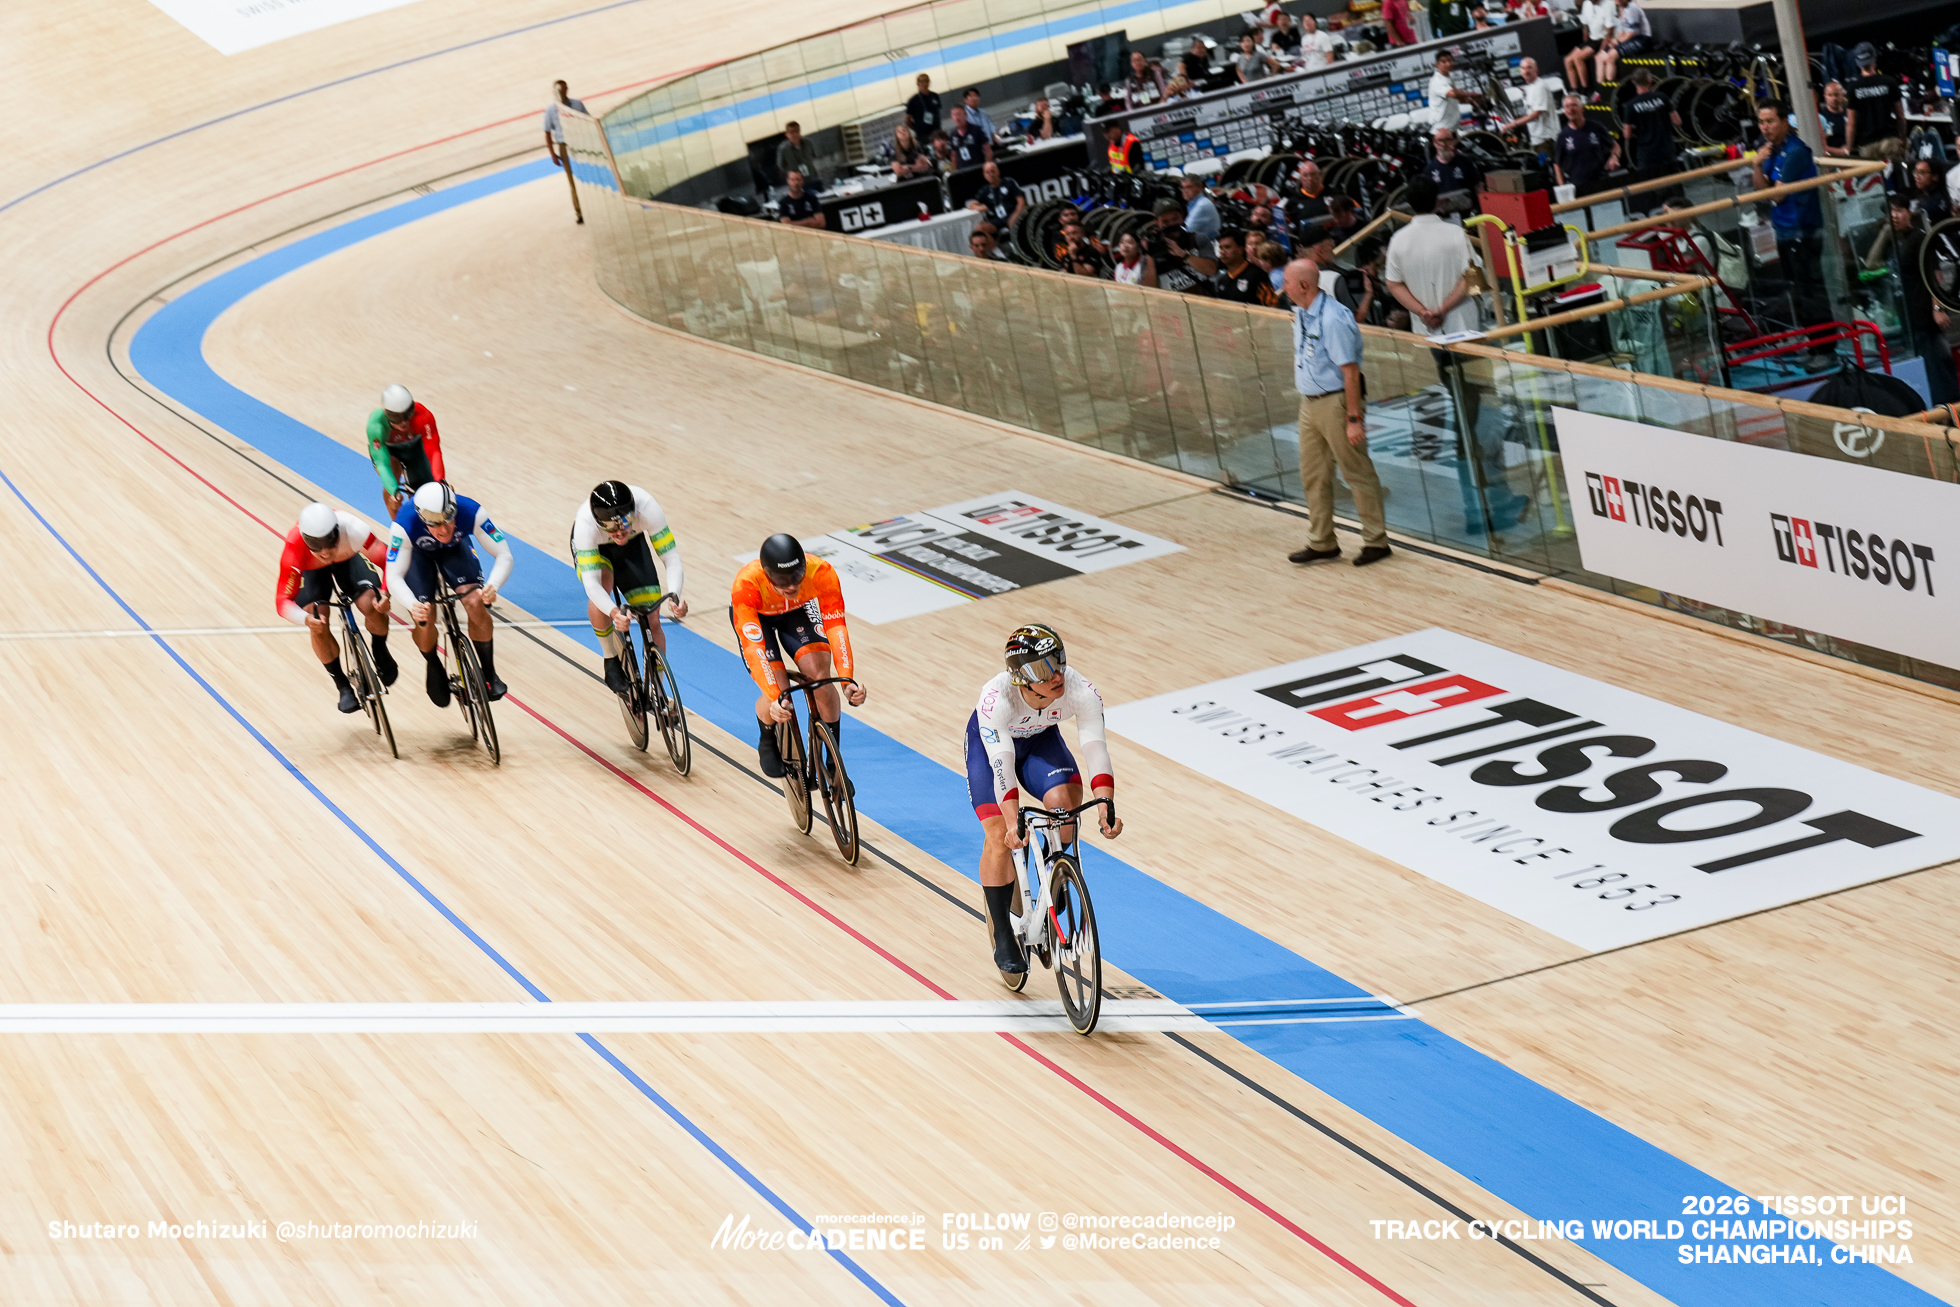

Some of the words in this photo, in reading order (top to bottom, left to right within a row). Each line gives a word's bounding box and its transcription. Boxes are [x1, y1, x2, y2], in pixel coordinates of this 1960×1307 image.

[996, 512, 1147, 559] TISSOT
[1622, 478, 1725, 548] TISSOT
[1814, 520, 1936, 598] TISSOT
[836, 629, 850, 669] Rabobank
[981, 688, 1000, 720] AEON
[1171, 700, 1285, 745] SWISS
[1266, 740, 1444, 811] WATCHES
[1426, 810, 1574, 866] SINCE
[1552, 864, 1682, 912] 1853
[1385, 697, 1926, 876] TISSOT
